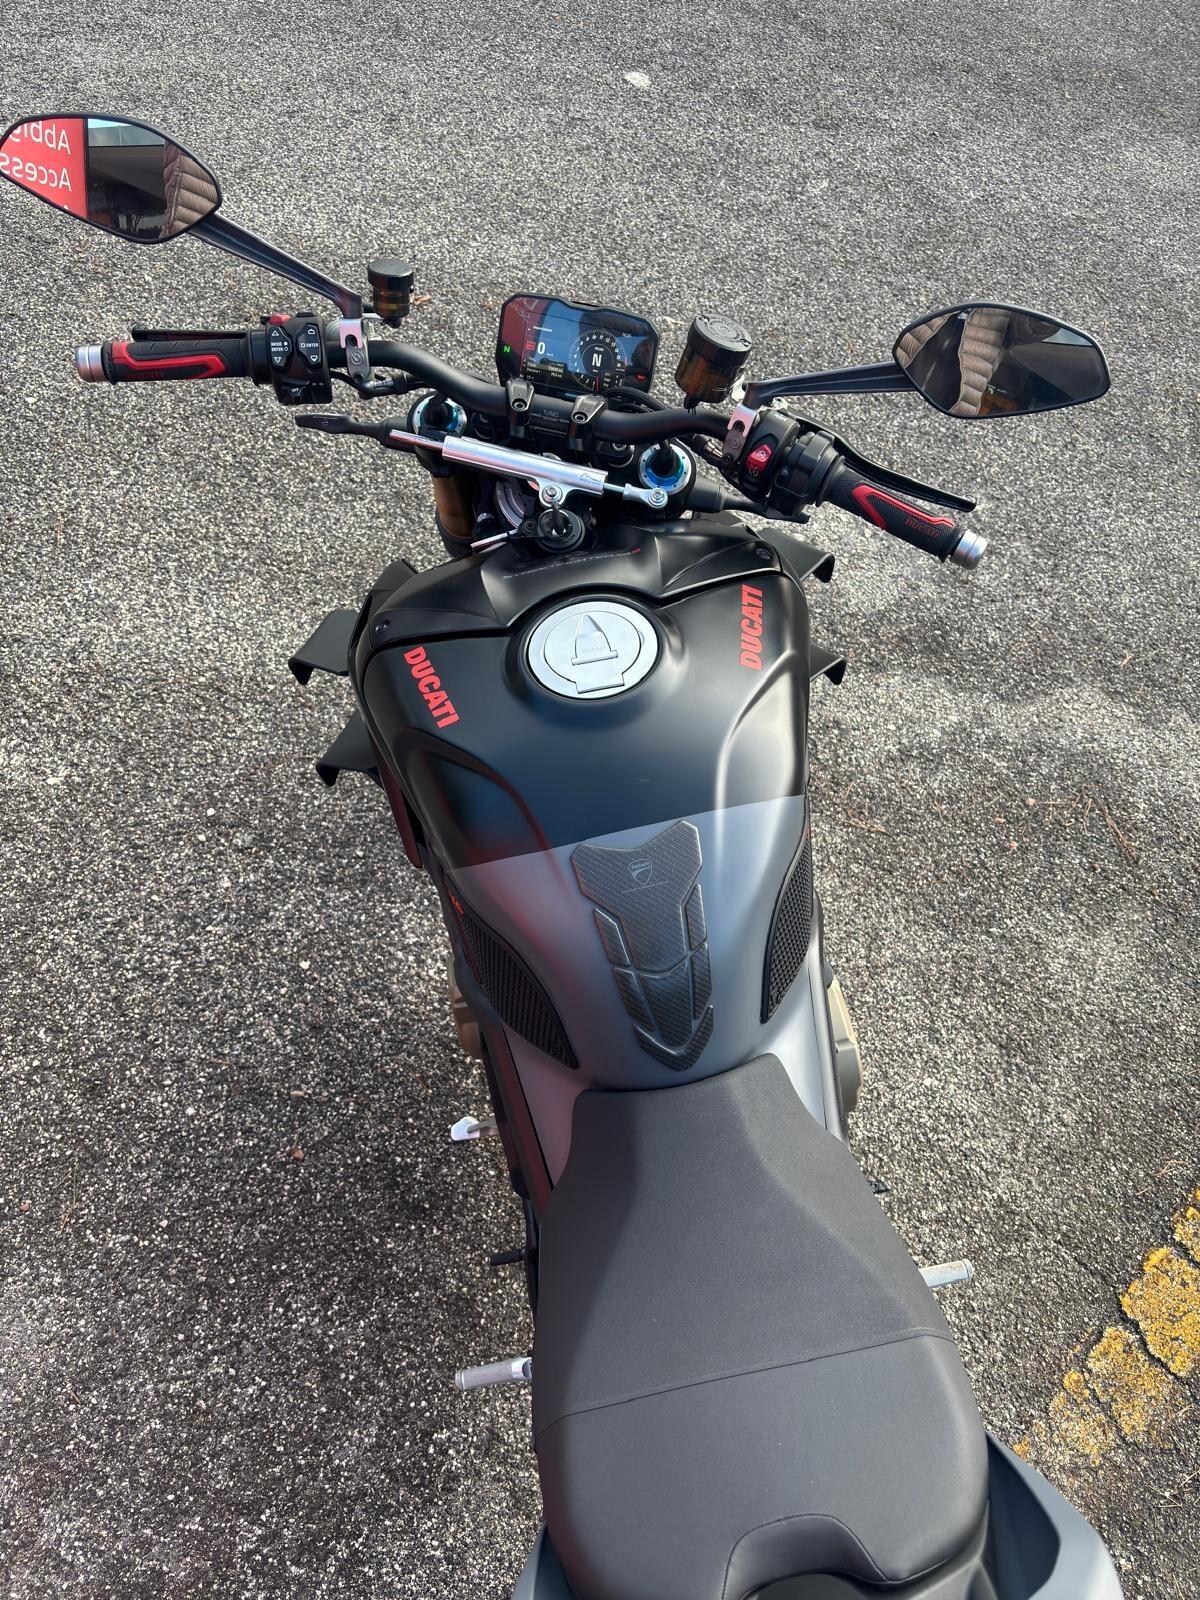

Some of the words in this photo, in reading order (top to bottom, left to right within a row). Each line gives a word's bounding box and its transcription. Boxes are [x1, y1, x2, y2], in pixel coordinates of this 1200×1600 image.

[503, 345, 511, 353] N
[537, 341, 545, 355] 0
[592, 353, 602, 367] N
[740, 583, 763, 671] DUCATI
[403, 646, 460, 729] DUCATI
